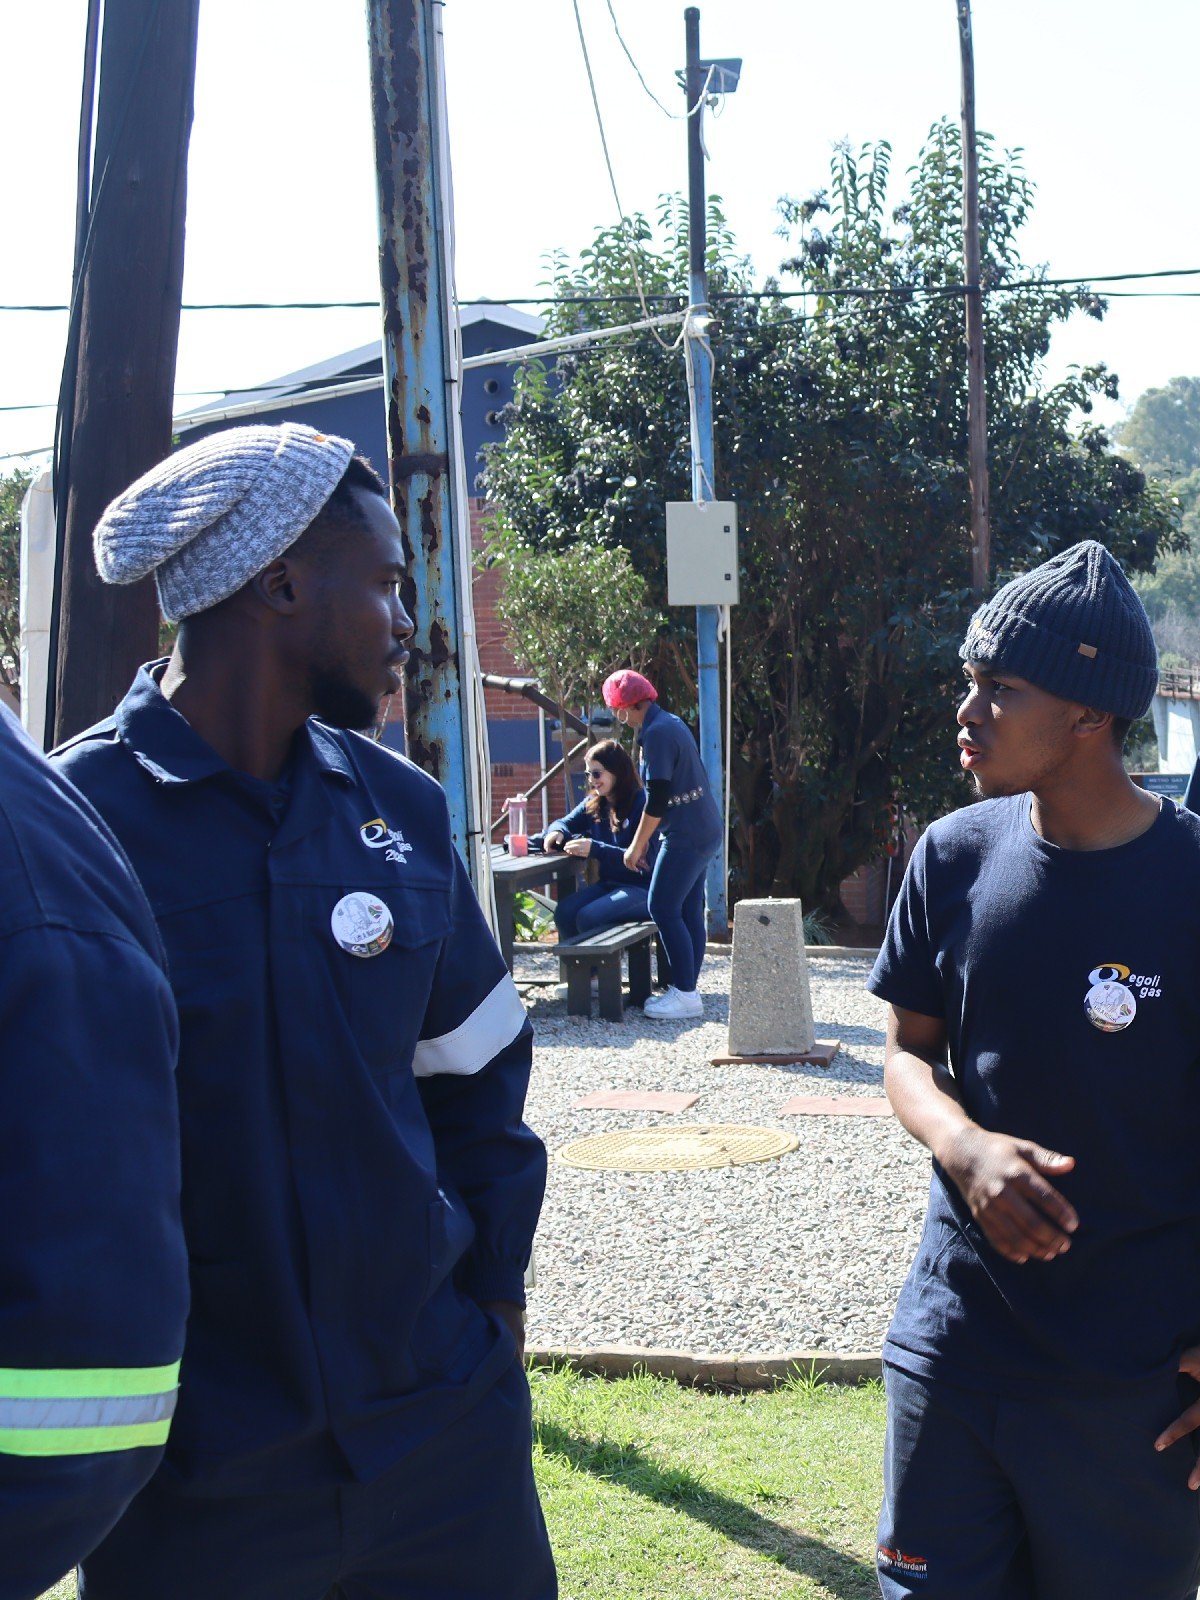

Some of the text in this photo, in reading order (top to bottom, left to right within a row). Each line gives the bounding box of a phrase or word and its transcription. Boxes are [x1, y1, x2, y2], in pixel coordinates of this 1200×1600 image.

[1129, 973, 1161, 988] egoli
[1139, 987, 1162, 999] gas
[894, 1560, 928, 1572] retardant
